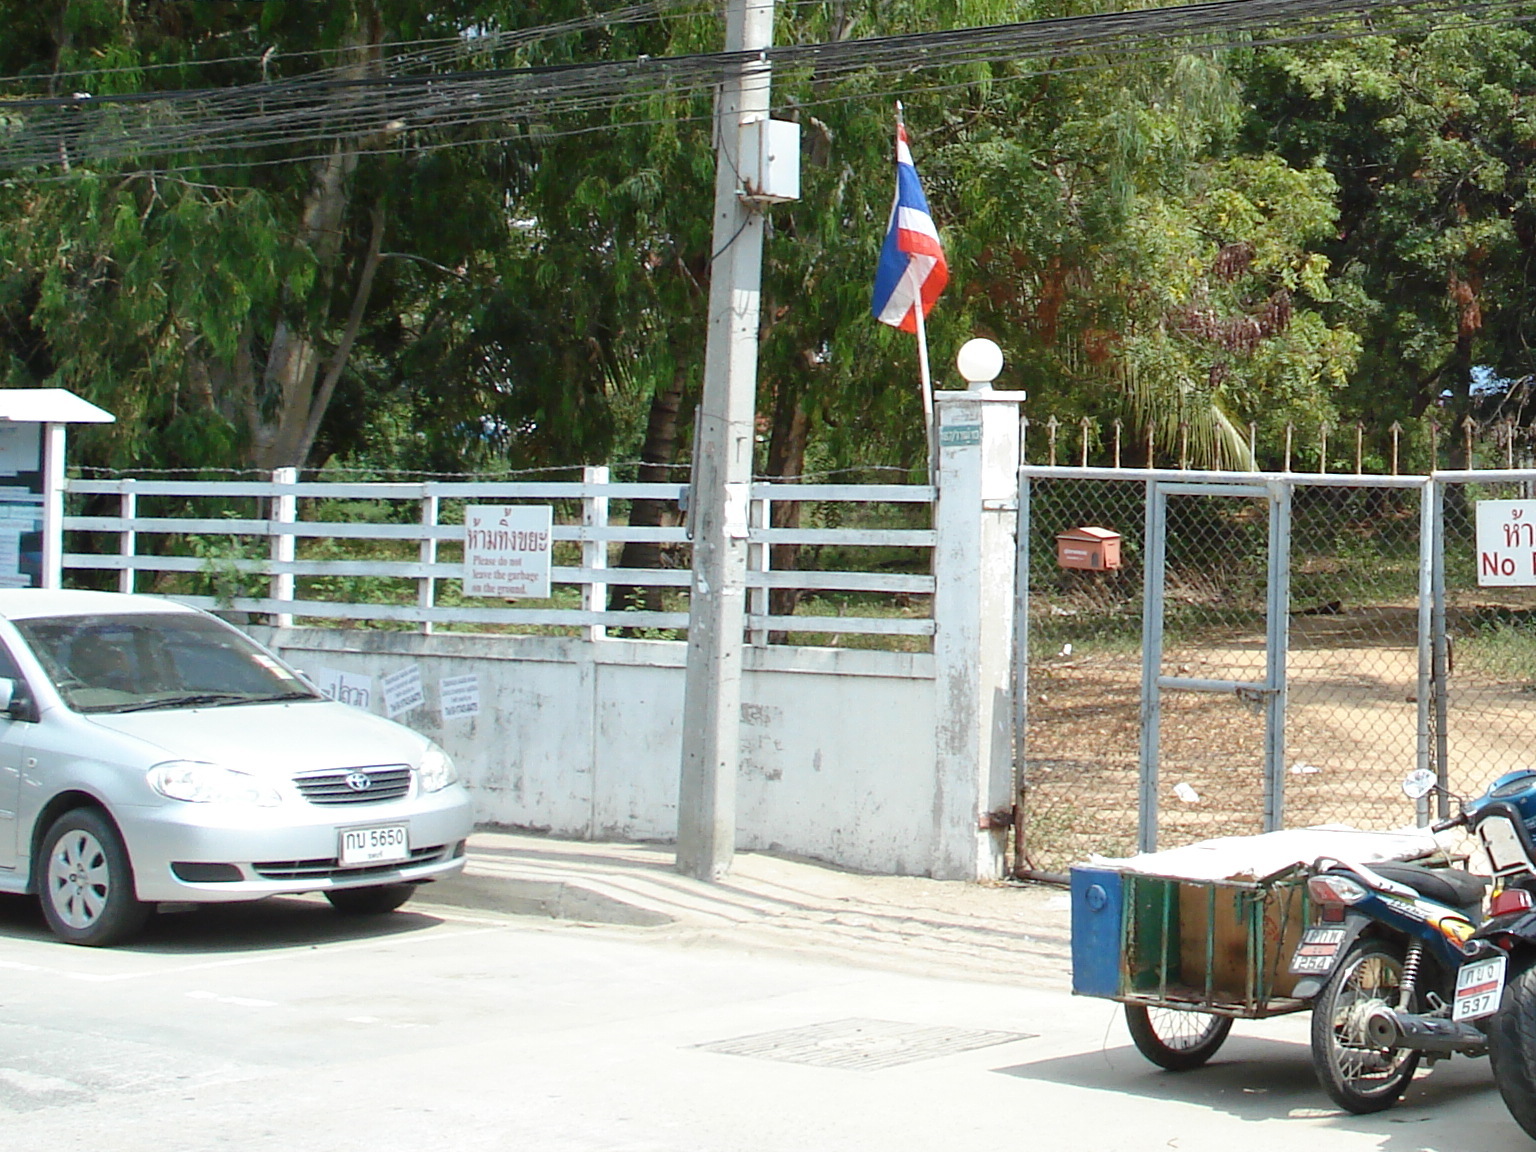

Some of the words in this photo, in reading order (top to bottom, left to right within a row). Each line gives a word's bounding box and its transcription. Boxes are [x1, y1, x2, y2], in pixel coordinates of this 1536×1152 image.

[467, 507, 549, 552] ห้ามทิ้งขยะ
[473, 555, 496, 566] Please
[498, 556, 507, 566] do
[509, 557, 522, 566] not
[1482, 552, 1515, 576] No
[472, 569, 491, 579] leave
[494, 569, 505, 580] the
[507, 570, 539, 582] garbage
[472, 584, 481, 592] on
[483, 582, 495, 593] the
[370, 828, 403, 847] 5650
[1461, 995, 1491, 1015] 537
